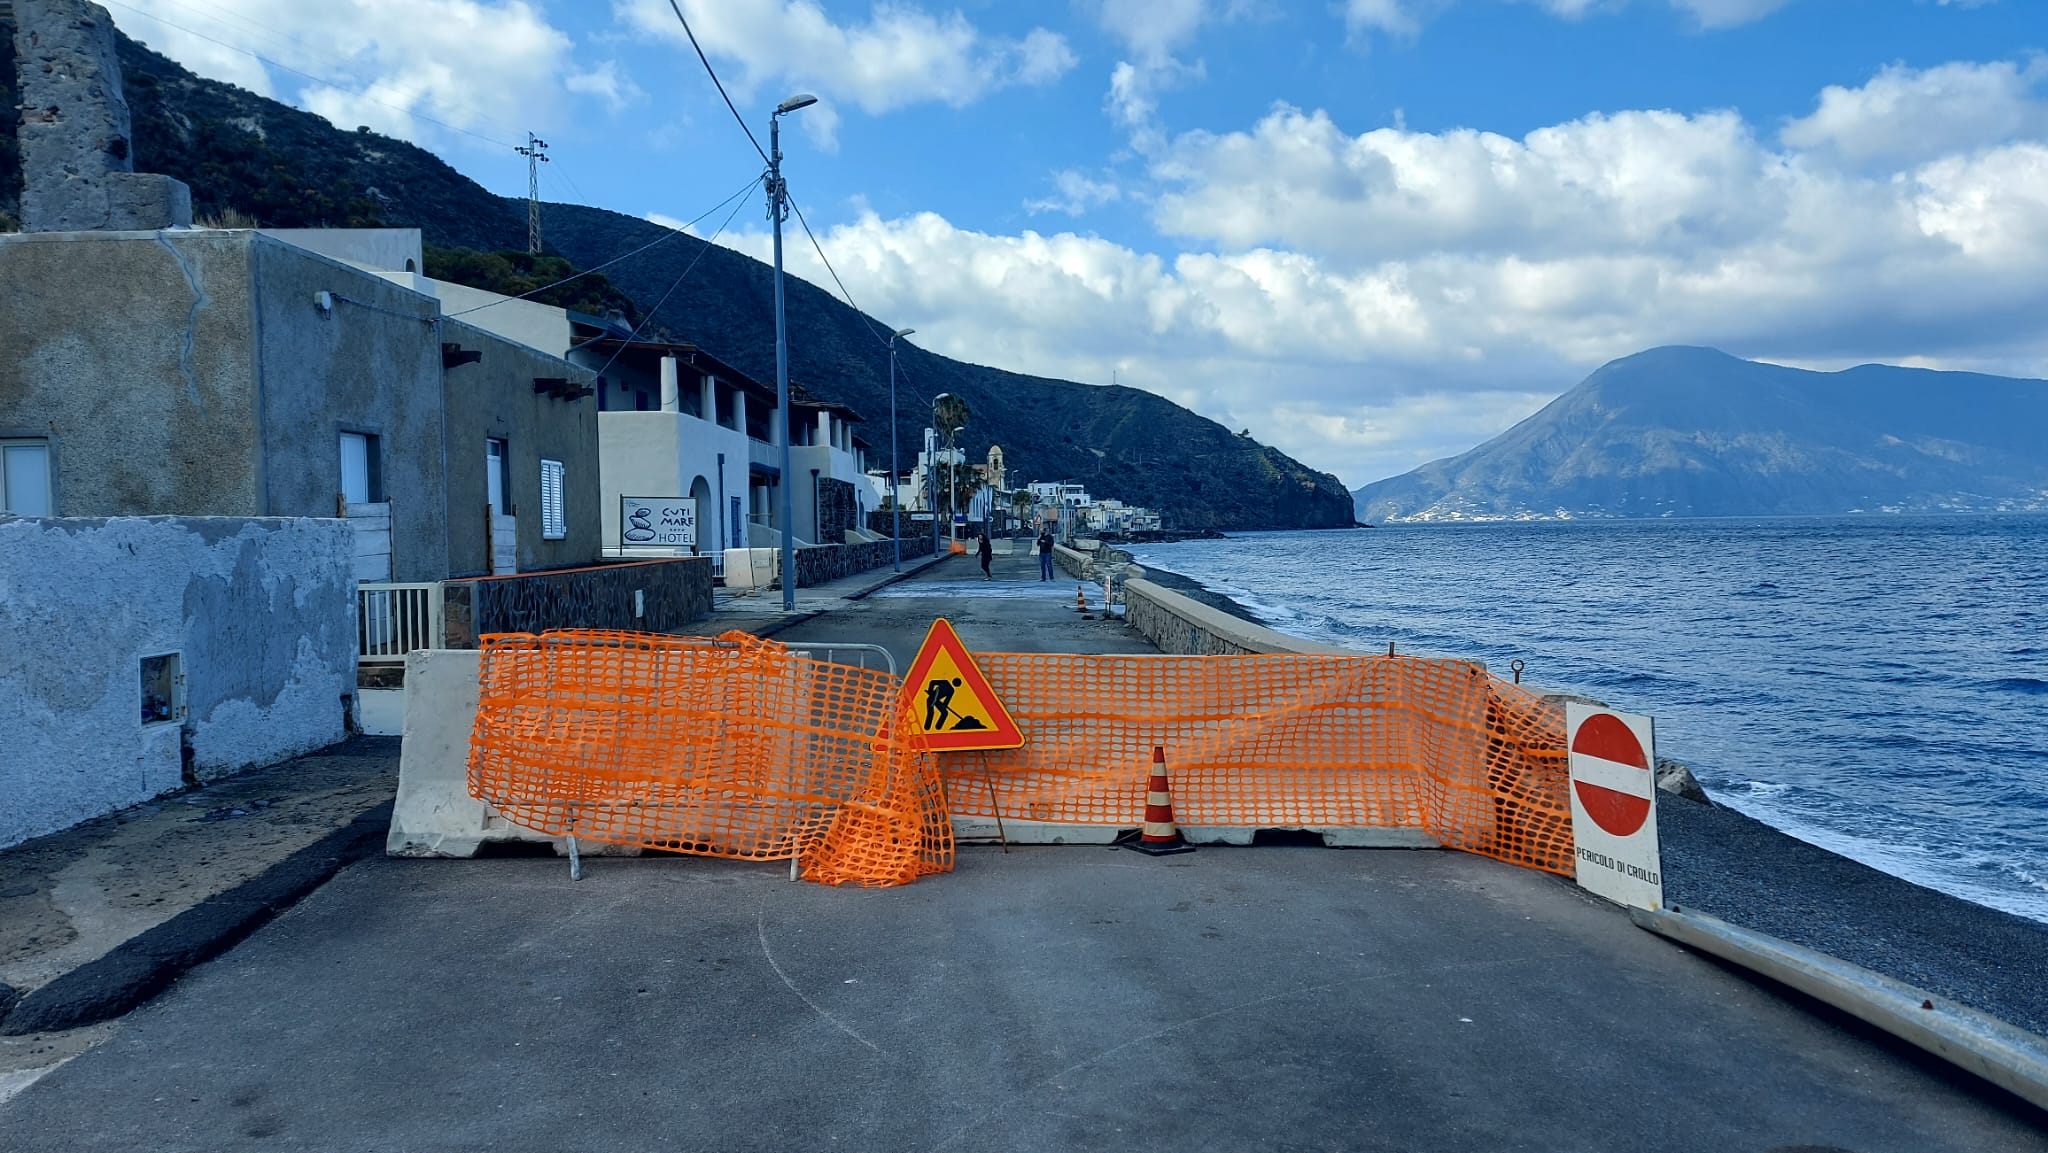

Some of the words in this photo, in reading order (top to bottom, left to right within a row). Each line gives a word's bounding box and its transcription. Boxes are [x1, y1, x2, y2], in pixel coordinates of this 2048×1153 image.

[662, 508, 690, 516] CUTI
[660, 517, 694, 527] MARE
[659, 533, 694, 543] HOTEL
[1576, 847, 1614, 869] PERICOLO
[1617, 860, 1625, 873] DI
[1627, 864, 1659, 885] CROLLO
